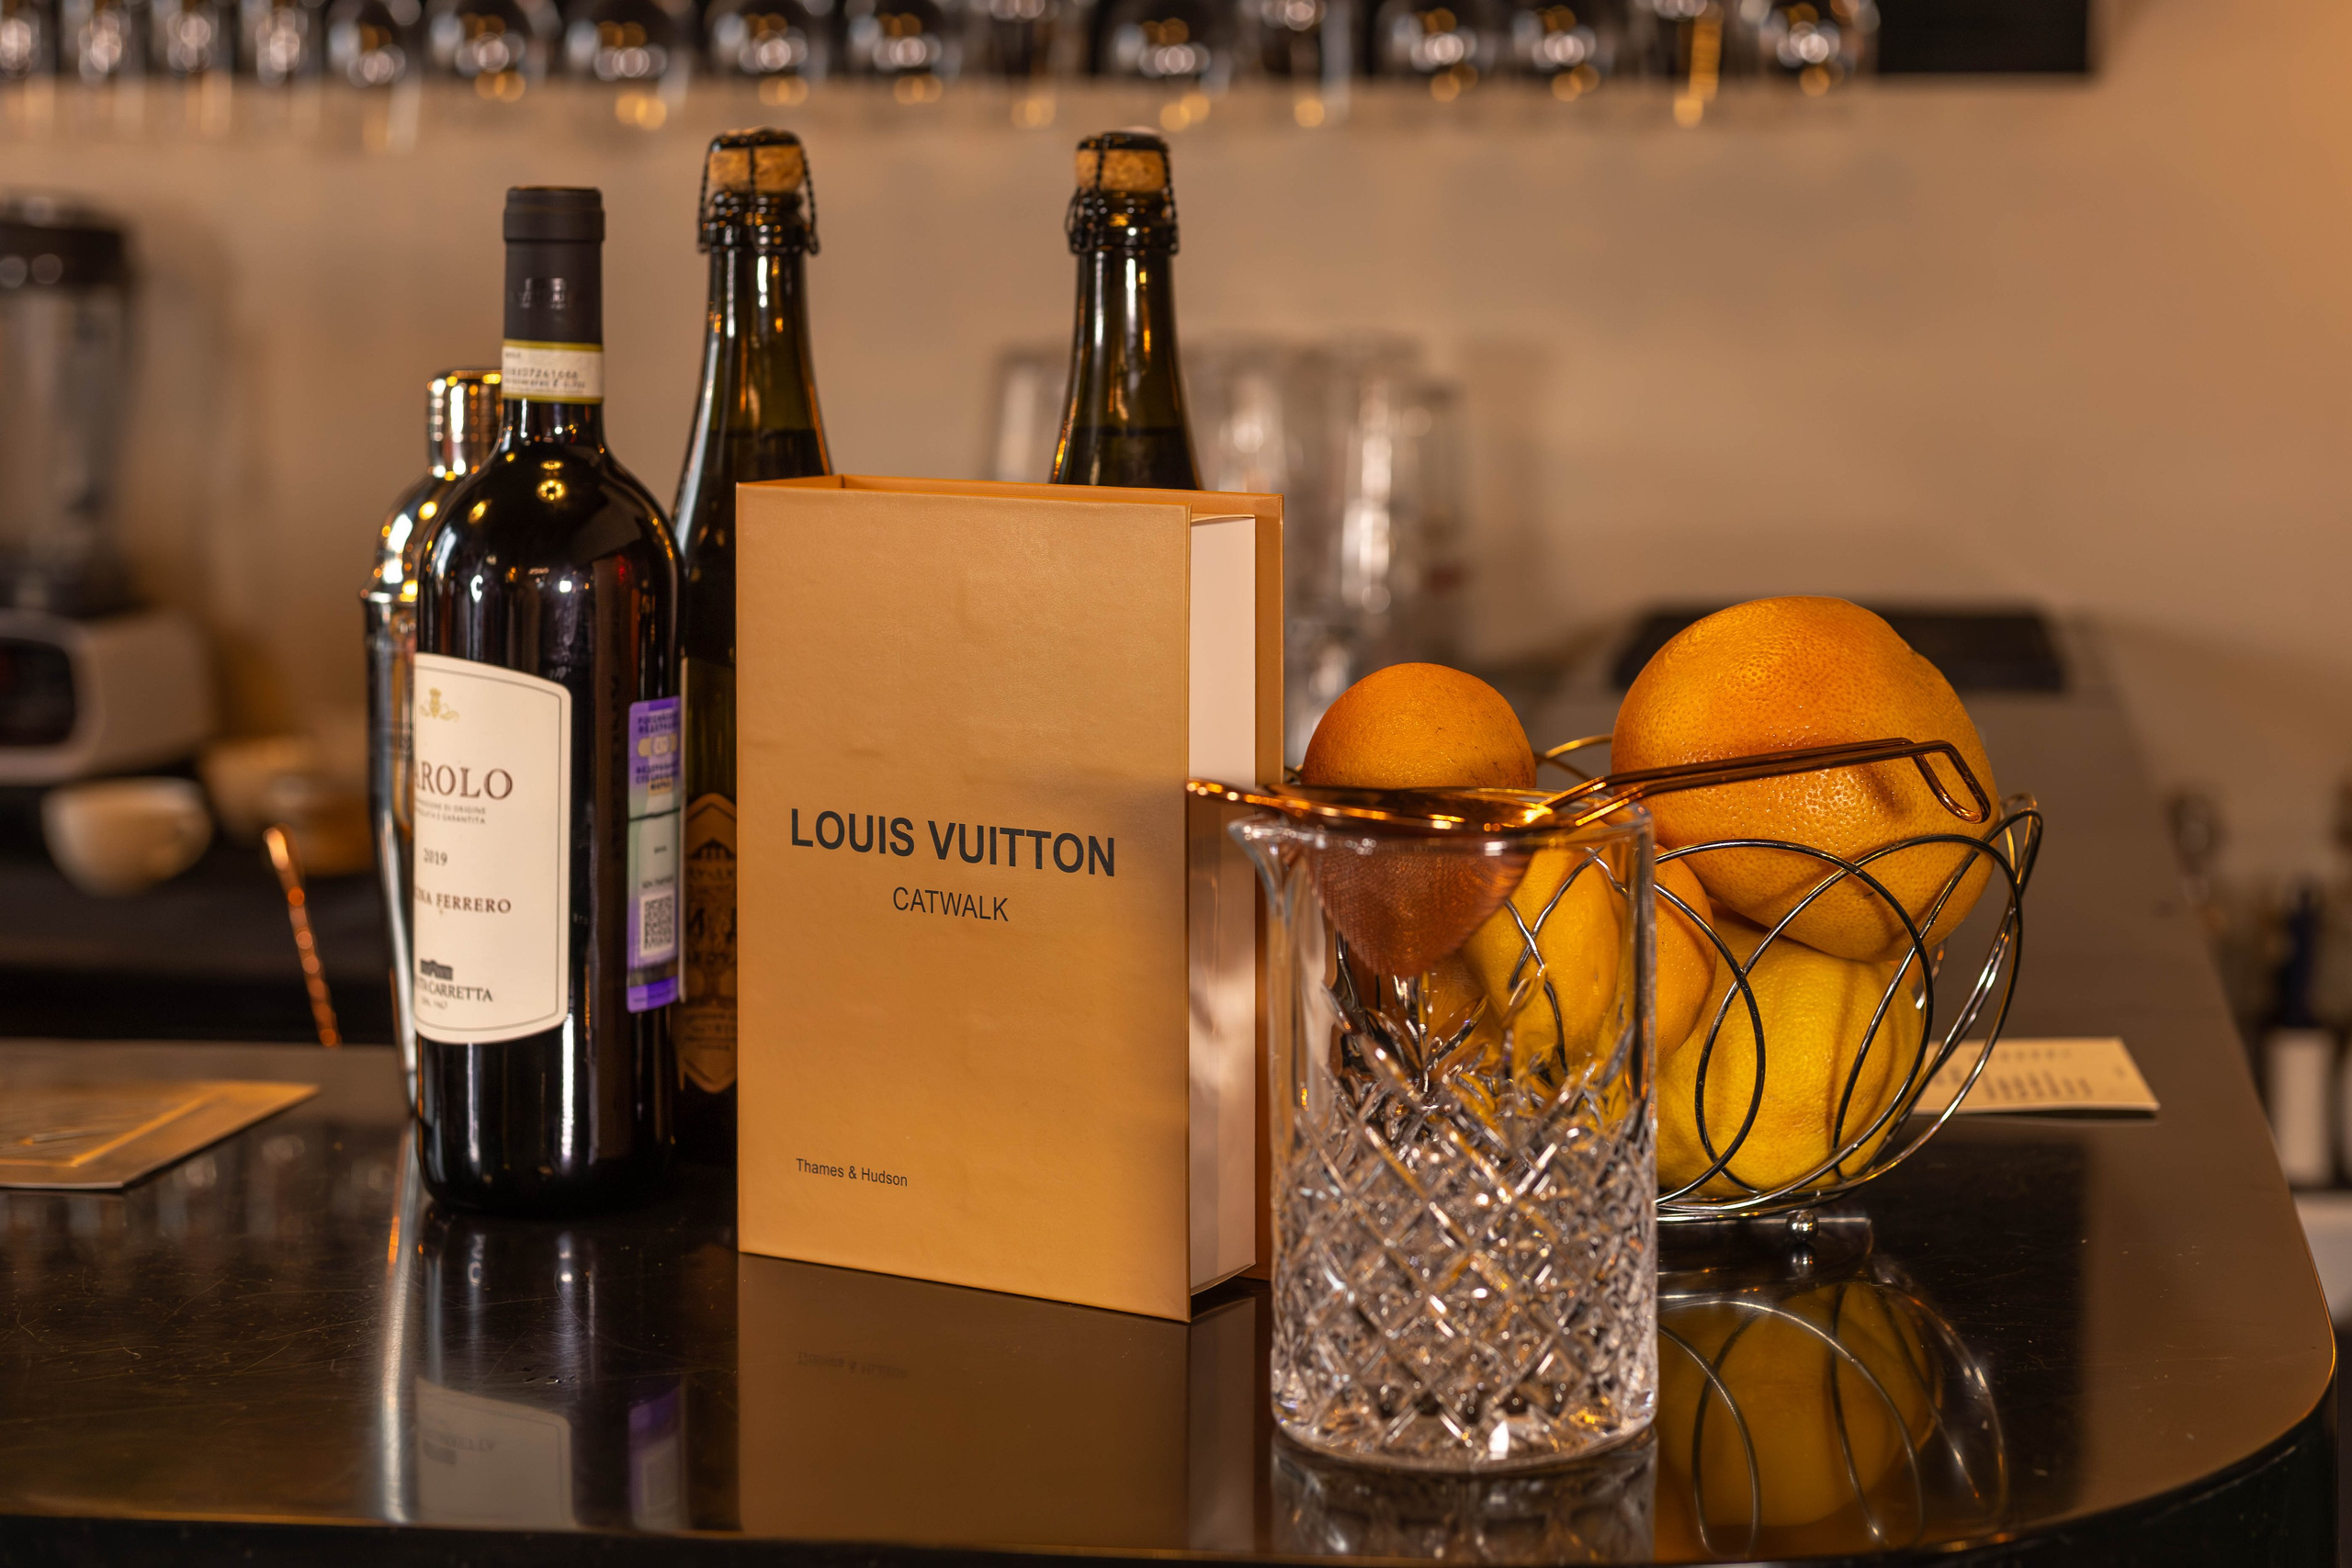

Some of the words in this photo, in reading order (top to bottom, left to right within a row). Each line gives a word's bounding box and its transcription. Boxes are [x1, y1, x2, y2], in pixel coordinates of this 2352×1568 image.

[791, 807, 915, 857] LOUIS
[927, 819, 1115, 877] VUITTON
[424, 847, 448, 866] 2019
[435, 892, 512, 915] FERRERO
[892, 886, 1010, 922] CATWALK
[429, 979, 493, 1002] CARRETTA
[796, 1157, 844, 1178] Thames
[848, 1165, 857, 1180] &
[861, 1167, 908, 1187] Hudson
